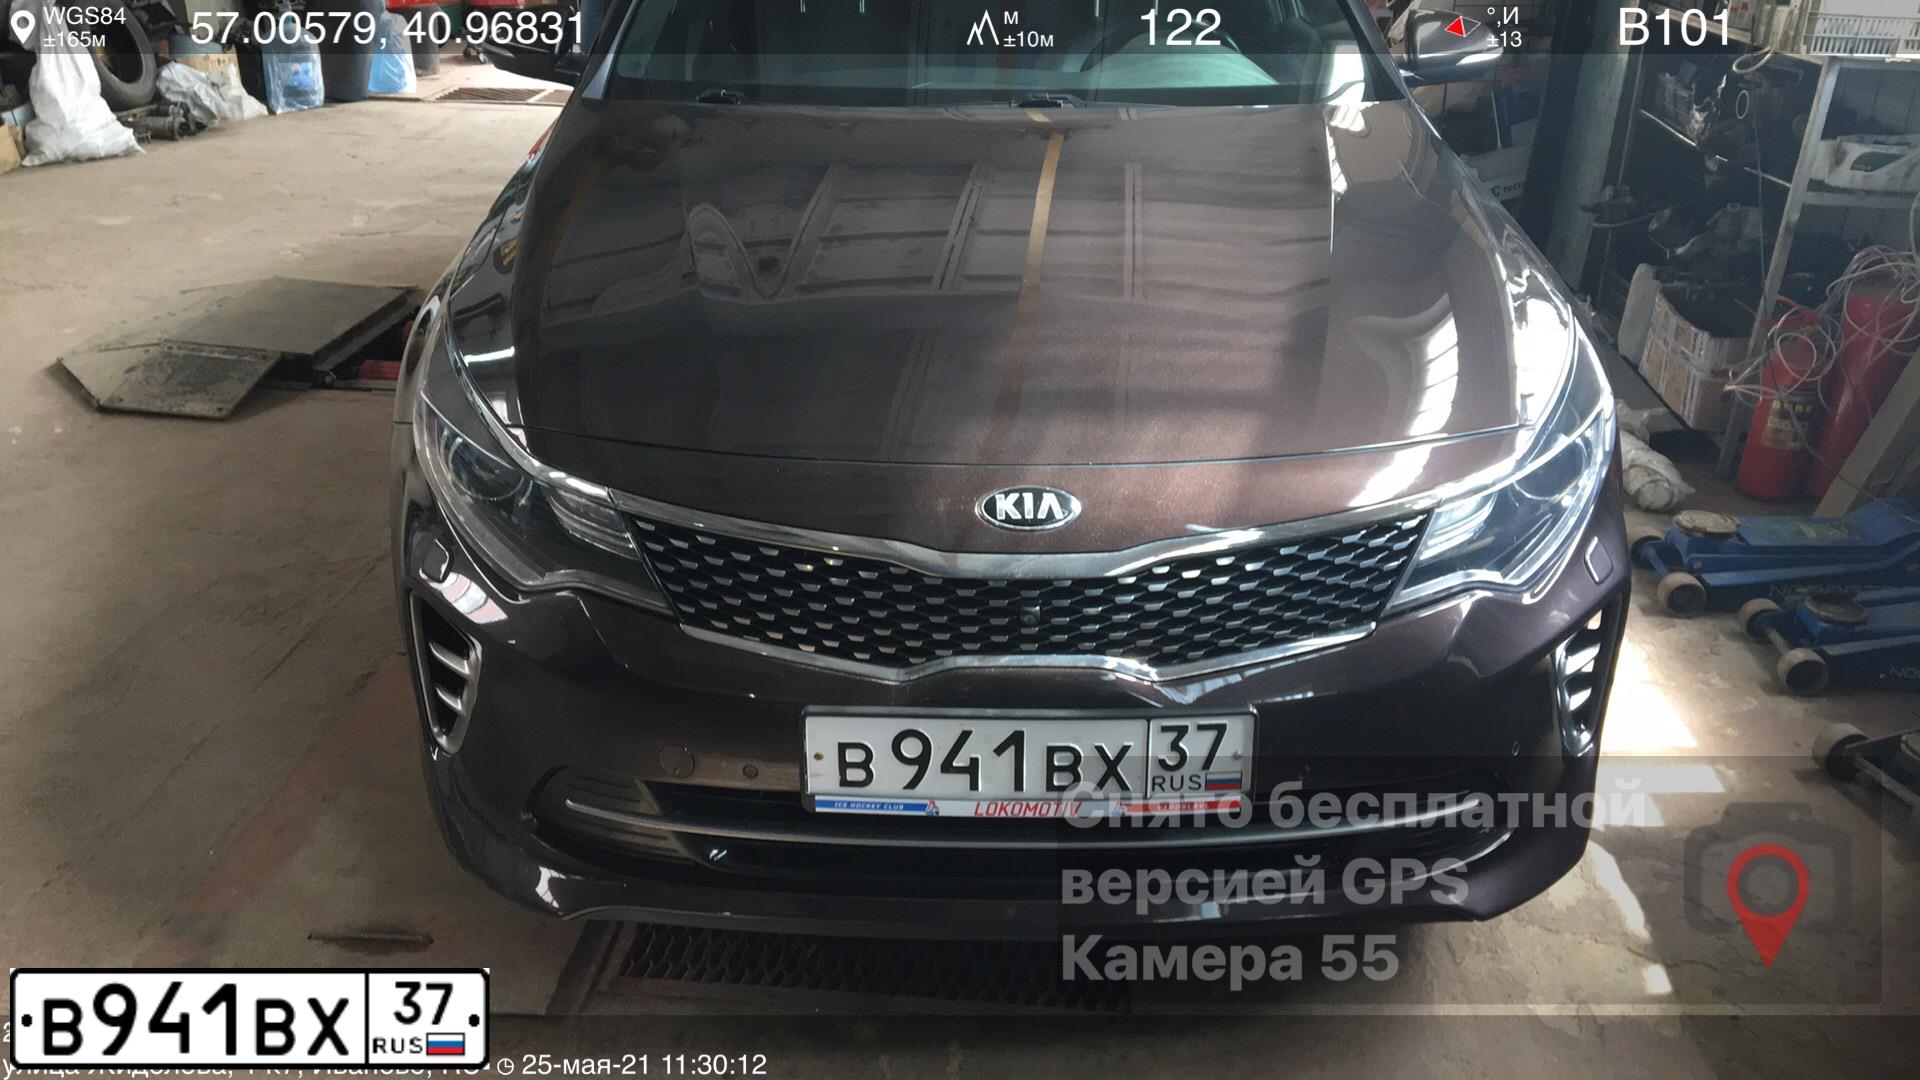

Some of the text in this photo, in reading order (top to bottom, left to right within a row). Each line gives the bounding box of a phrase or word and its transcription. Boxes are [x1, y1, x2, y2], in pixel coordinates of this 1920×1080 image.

[995, 492, 1064, 520] KIA
[1157, 722, 1227, 772] 37
[1151, 774, 1202, 792] RUS
[850, 802, 881, 810] HOCKEY
[883, 803, 905, 811] CLUB
[974, 801, 1081, 817] LOKOMOTIV
